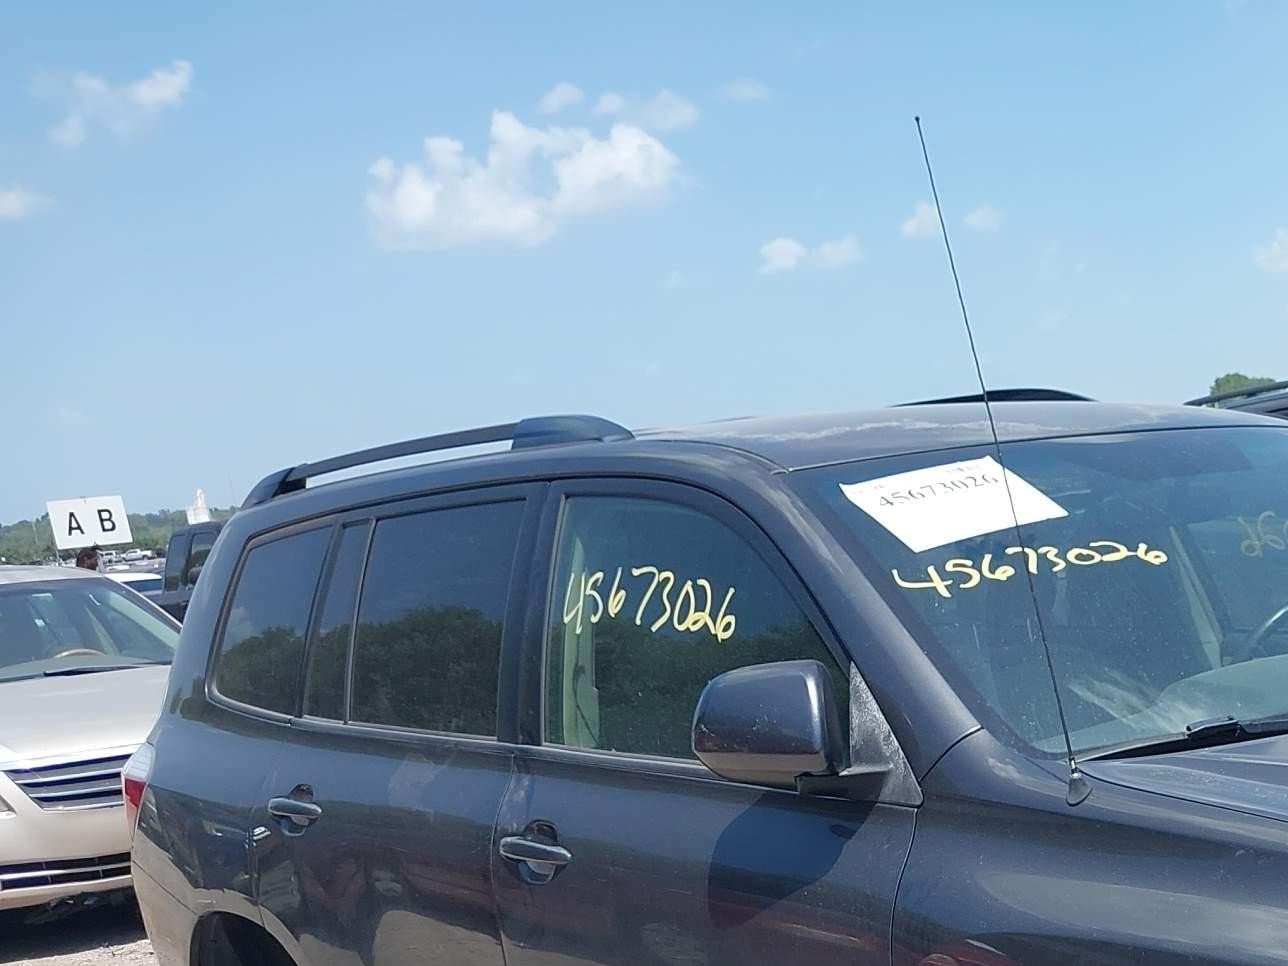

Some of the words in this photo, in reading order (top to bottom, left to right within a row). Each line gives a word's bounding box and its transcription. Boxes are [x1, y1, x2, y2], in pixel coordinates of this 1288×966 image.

[879, 472, 1000, 507] 45673026
[67, 511, 85, 536] A
[97, 508, 117, 533] B
[892, 540, 1168, 599] 45673026
[563, 566, 736, 643] 45673026
